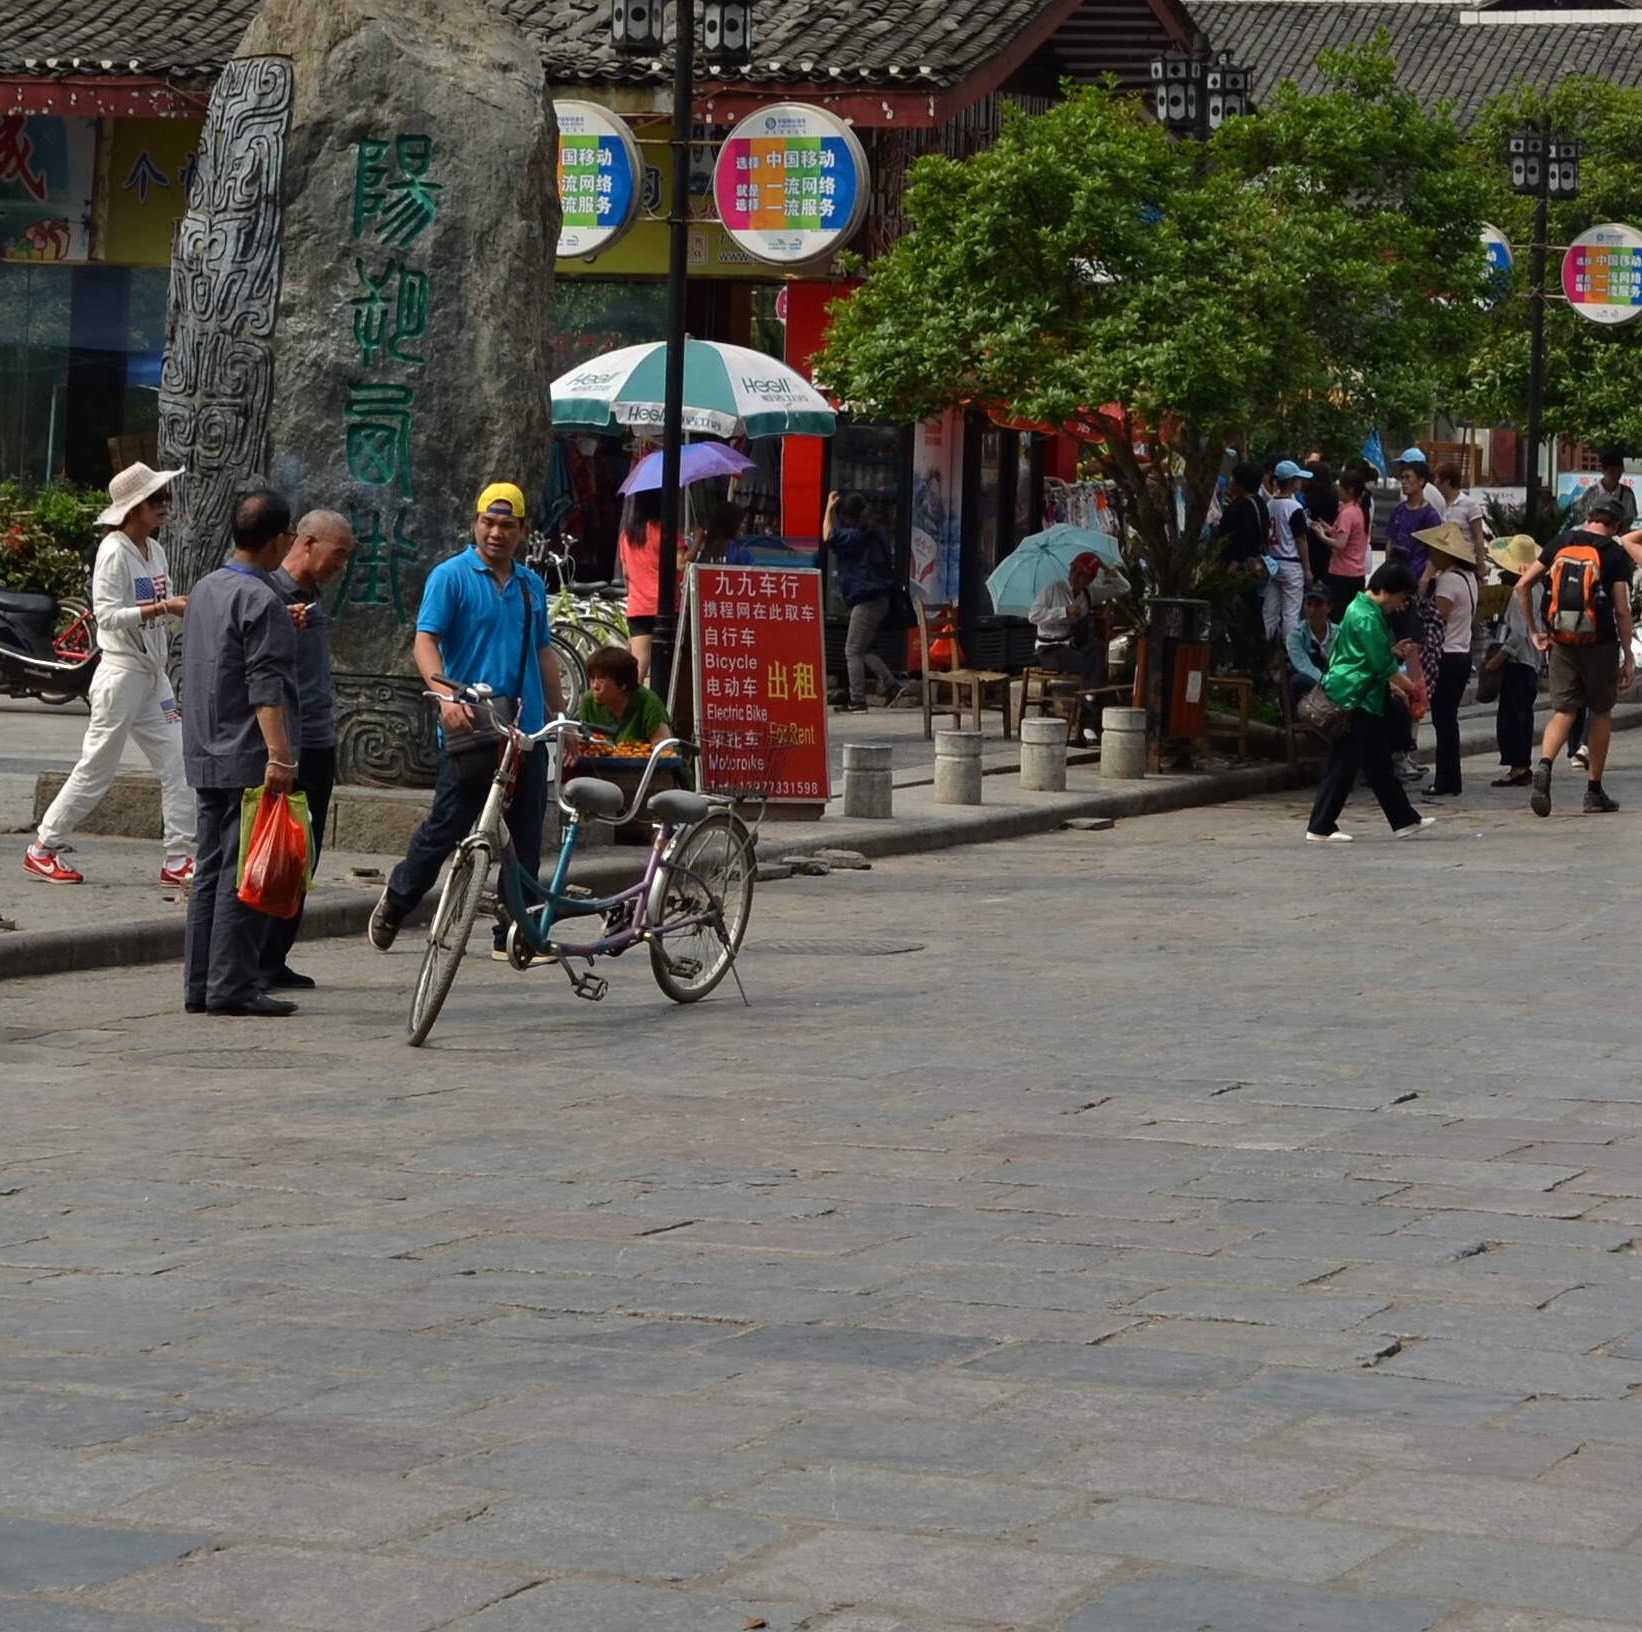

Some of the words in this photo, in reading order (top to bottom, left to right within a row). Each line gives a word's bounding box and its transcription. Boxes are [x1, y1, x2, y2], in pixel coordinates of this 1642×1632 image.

[561, 148, 612, 166] 国移动
[735, 156, 760, 170] 选择
[766, 149, 835, 169] 中国移动
[558, 174, 613, 193] 流网络
[735, 184, 760, 197] 就是
[766, 176, 835, 195] 一流网络
[561, 196, 612, 214] 流服务
[735, 198, 760, 211] 选择
[766, 198, 835, 217] 一流服务
[1596, 255, 1642, 267] 中国移动
[1596, 271, 1642, 284] 一流网络
[1596, 285, 1641, 298] 一流服务
[715, 571, 799, 599] 九九车行
[703, 601, 815, 622] 携程网在此取车
[705, 627, 755, 647] 自行车
[705, 653, 757, 673] Bicycle
[707, 676, 758, 698] 电动车
[768, 660, 818, 701] 出租
[707, 704, 744, 721] Electric
[746, 704, 768, 721] Bike
[790, 723, 815, 744] Rent
